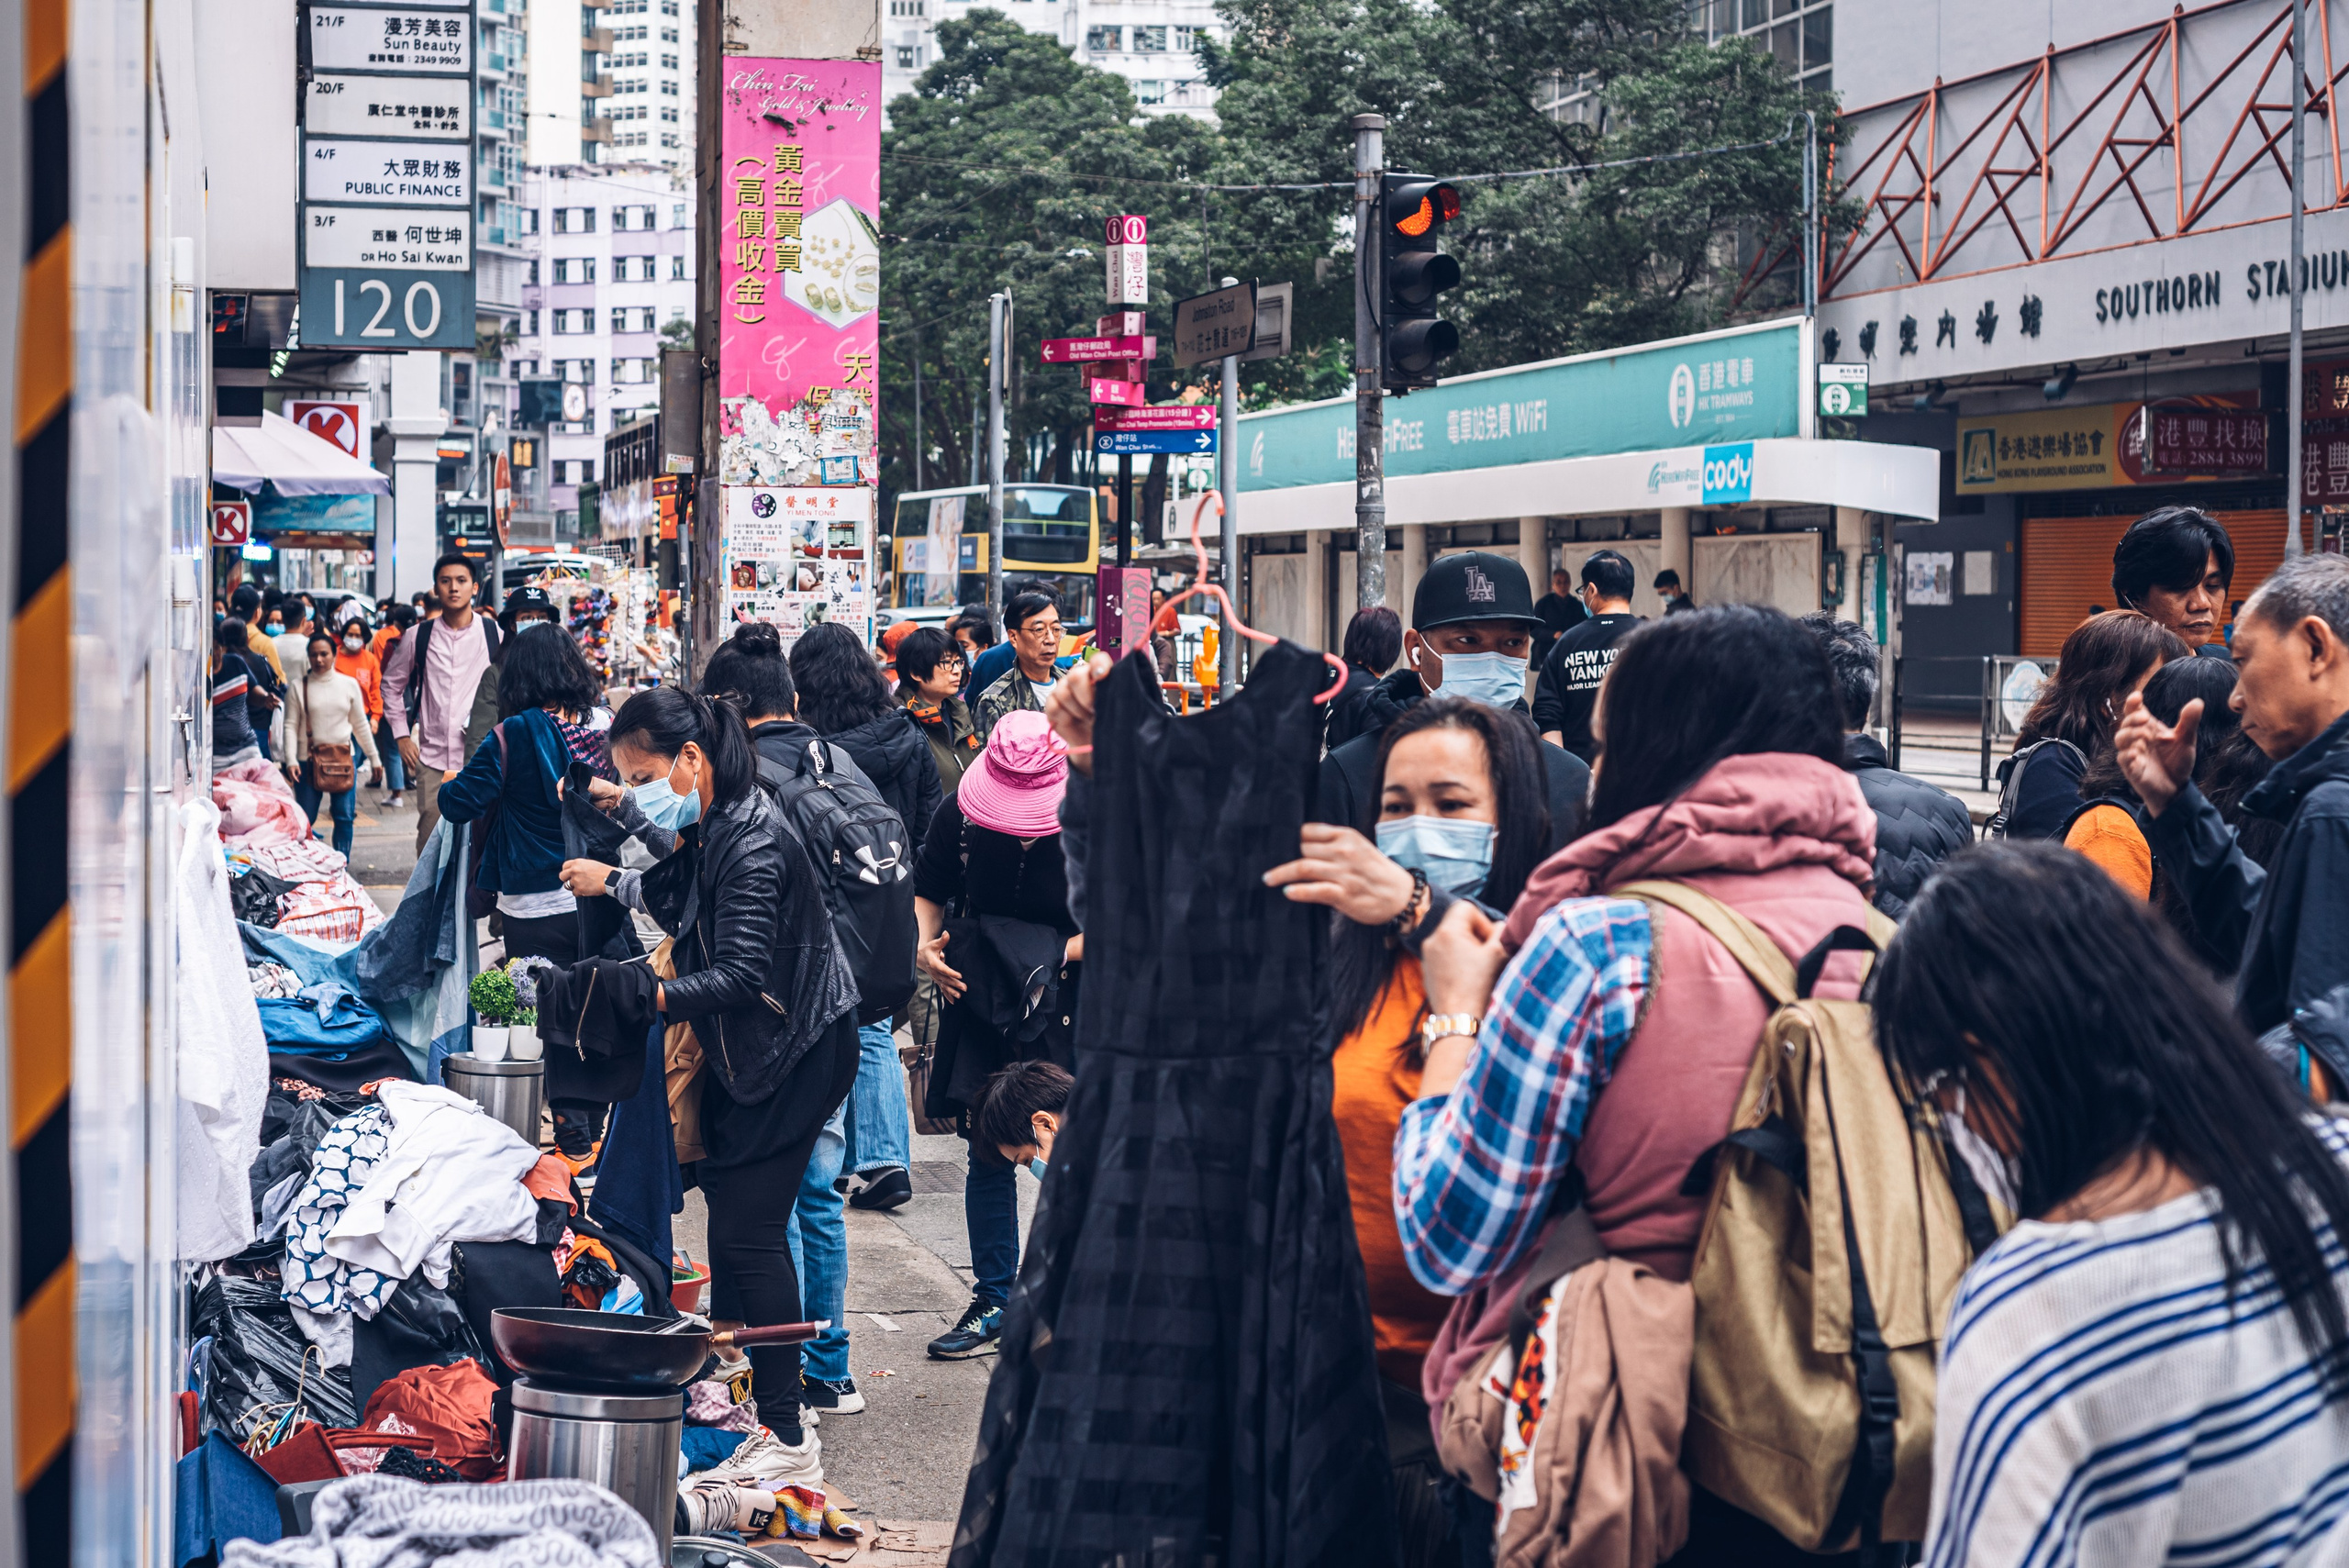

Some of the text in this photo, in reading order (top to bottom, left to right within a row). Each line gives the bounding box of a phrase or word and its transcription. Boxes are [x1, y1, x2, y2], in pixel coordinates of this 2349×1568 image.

[316, 16, 345, 28] 21/F
[384, 17, 461, 37] 漫芳美容
[384, 37, 461, 54] Sun Beauty
[414, 55, 436, 64] 2349
[439, 56, 462, 65] 9909
[316, 83, 345, 95] 20/F
[729, 67, 818, 93] Chin Fai
[757, 95, 870, 122] Gold & Jwellery
[315, 149, 336, 161] 4/F
[384, 159, 461, 178] 大眾財務
[345, 182, 462, 197] PUBLIC FINANCE
[773, 143, 804, 274] 黃金賣買
[315, 216, 336, 227] 3/F
[372, 226, 462, 245] 西醫 何世坤
[362, 250, 462, 264] DR Ho Sai Kwan
[1219, 296, 1234, 315] Road
[2096, 270, 2221, 323] SOUTHORN
[335, 279, 441, 339] 120
[1094, 350, 1107, 358] Chai
[1108, 349, 1121, 357] Post
[1122, 348, 1140, 356] Office
[1698, 357, 1753, 392] 香港電車
[1698, 391, 1753, 410] HK TRAMWAYS
[1447, 399, 1546, 444] 電車站免費 WiFi
[1115, 434, 1137, 442] 灣仔站
[2190, 451, 2223, 465] 2884
[2228, 451, 2263, 465] 3899
[1705, 453, 1752, 490] cody
[1998, 469, 2013, 478] HONG
[2069, 463, 2107, 474] ASSOCIATION
[216, 511, 242, 537] K
[1465, 565, 1496, 602] LA
[1564, 651, 1599, 668] NEW
